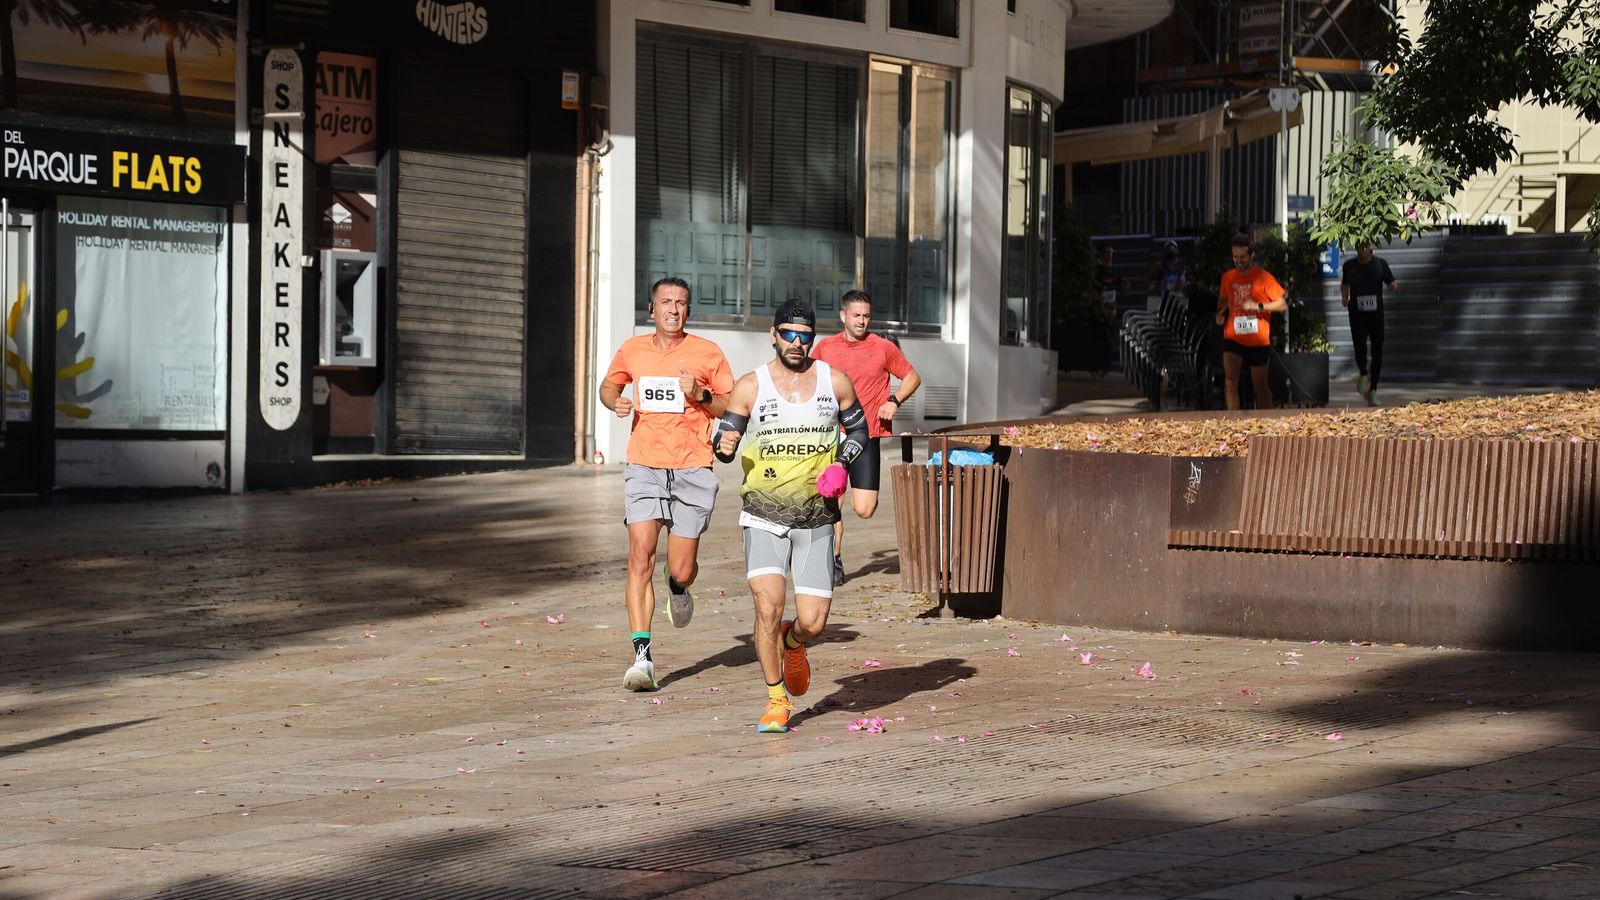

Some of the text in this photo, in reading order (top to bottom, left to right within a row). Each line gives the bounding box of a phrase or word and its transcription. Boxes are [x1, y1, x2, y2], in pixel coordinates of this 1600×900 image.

[416, 0, 488, 44] HUNTERS
[271, 60, 294, 72] SHOP
[316, 106, 373, 138] ajero
[4, 130, 25, 144] DEL
[4, 147, 202, 194] PARQUE FLATS
[58, 212, 224, 235] HOLIDAY RENTAL MANAGEMENT
[273, 83, 291, 387] SNEAKERS
[270, 397, 293, 407] SHOP
[645, 388, 676, 401] 965
[773, 425, 811, 435] TRIATLÓN
